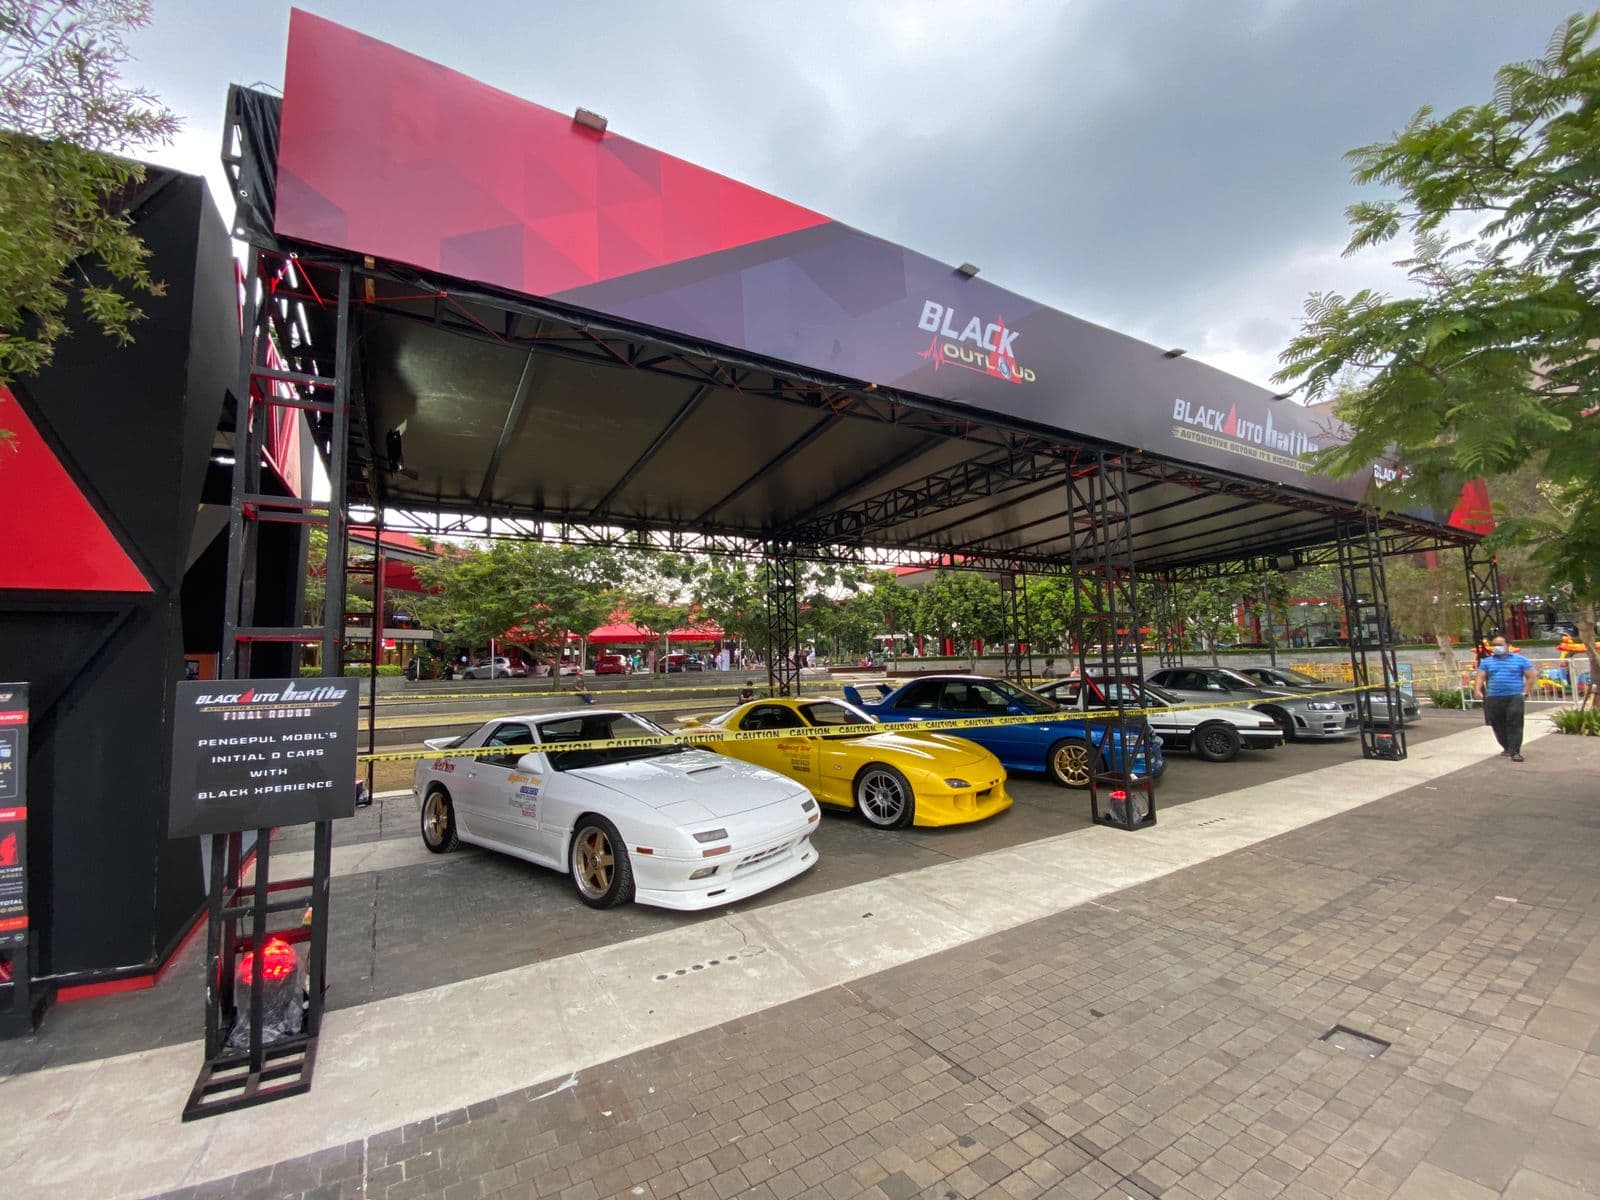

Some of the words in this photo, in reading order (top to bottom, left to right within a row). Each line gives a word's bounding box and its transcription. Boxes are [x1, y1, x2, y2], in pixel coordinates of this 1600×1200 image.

[918, 300, 1019, 358] BLACK
[1180, 428, 1229, 450] AUTOMOTIVE
[223, 710, 263, 721] FINAL
[268, 708, 312, 719] ROUND
[198, 736, 277, 747] PENGEPUL
[282, 732, 337, 742] MOBIL'S
[606, 738, 663, 749] CAUTION
[674, 733, 724, 745] CAUTION
[735, 730, 780, 740] CAUTION
[789, 727, 830, 737] CAUTION
[838, 725, 877, 734] CAUTION
[884, 723, 919, 731] CAUTION
[925, 721, 958, 729] CAUTION
[963, 719, 994, 727] CAUTION
[999, 716, 1028, 724] CAUTION
[1032, 715, 1059, 723] CAUTION
[212, 753, 266, 764] INITIAL
[271, 751, 281, 759] D
[286, 749, 325, 758] CARS
[250, 768, 288, 778] WITH
[197, 788, 249, 800] BLACK
[254, 780, 333, 795] XPERIENCE
